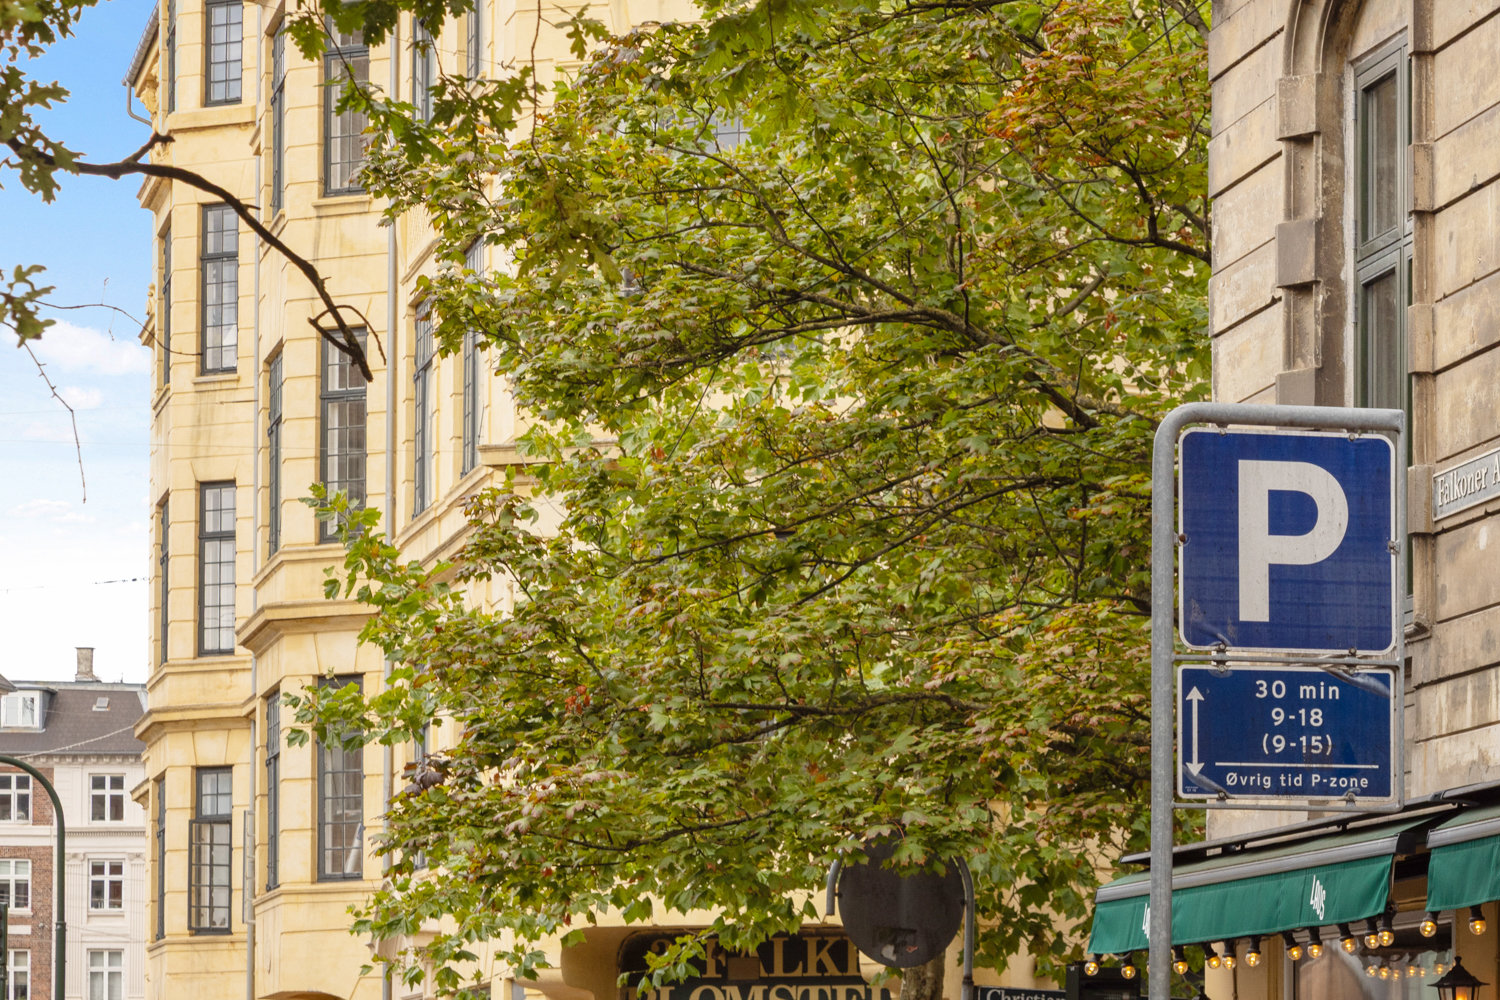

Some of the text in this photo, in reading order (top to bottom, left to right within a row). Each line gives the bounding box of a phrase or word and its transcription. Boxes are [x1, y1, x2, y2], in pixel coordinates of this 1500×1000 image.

[1438, 466, 1488, 507] Falkoner
[1238, 459, 1349, 622] P
[1255, 680, 1340, 699] 30 min
[1271, 708, 1324, 726] 9-18
[1262, 733, 1333, 755] (9-15)
[1226, 772, 1369, 789] Øvrig tid P-zone
